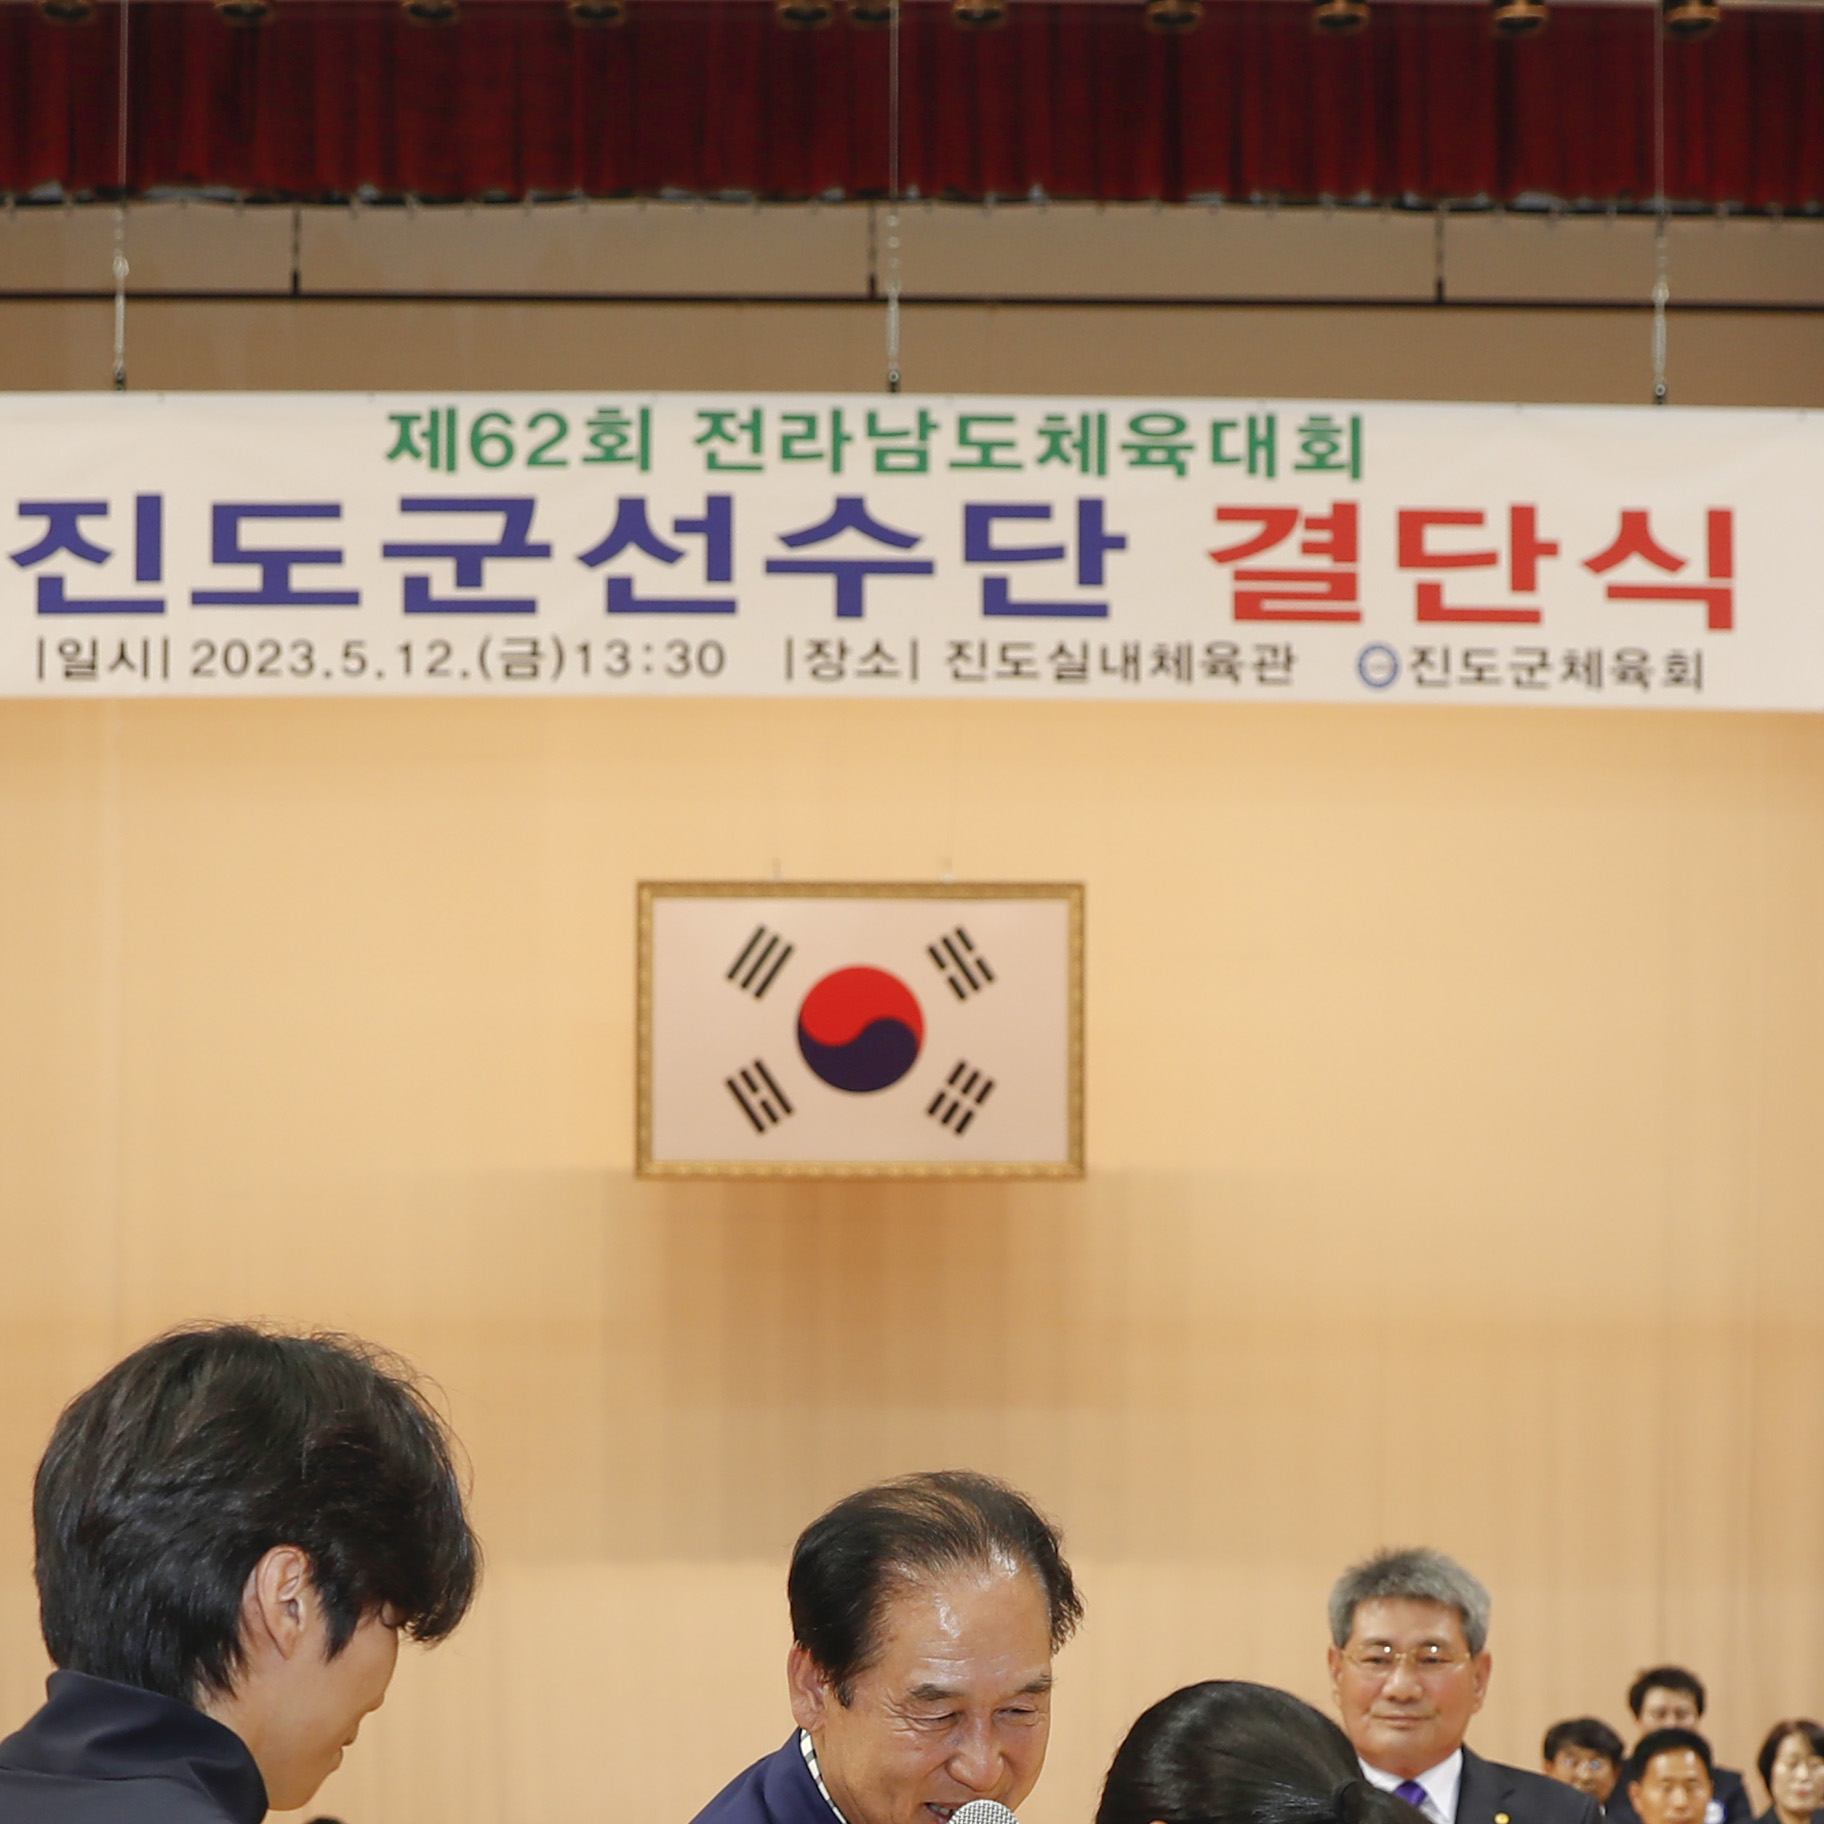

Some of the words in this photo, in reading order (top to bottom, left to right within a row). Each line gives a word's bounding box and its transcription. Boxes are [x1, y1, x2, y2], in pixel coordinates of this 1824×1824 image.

[385, 405, 653, 474] 제62회
[692, 406, 1365, 481] 전라남도체육대회
[8, 492, 1128, 620] 진도군선수단
[1206, 499, 1736, 632] 결단식
[944, 639, 1297, 687] 진도실내체육관
[1408, 645, 1705, 692] 진도군체육회
